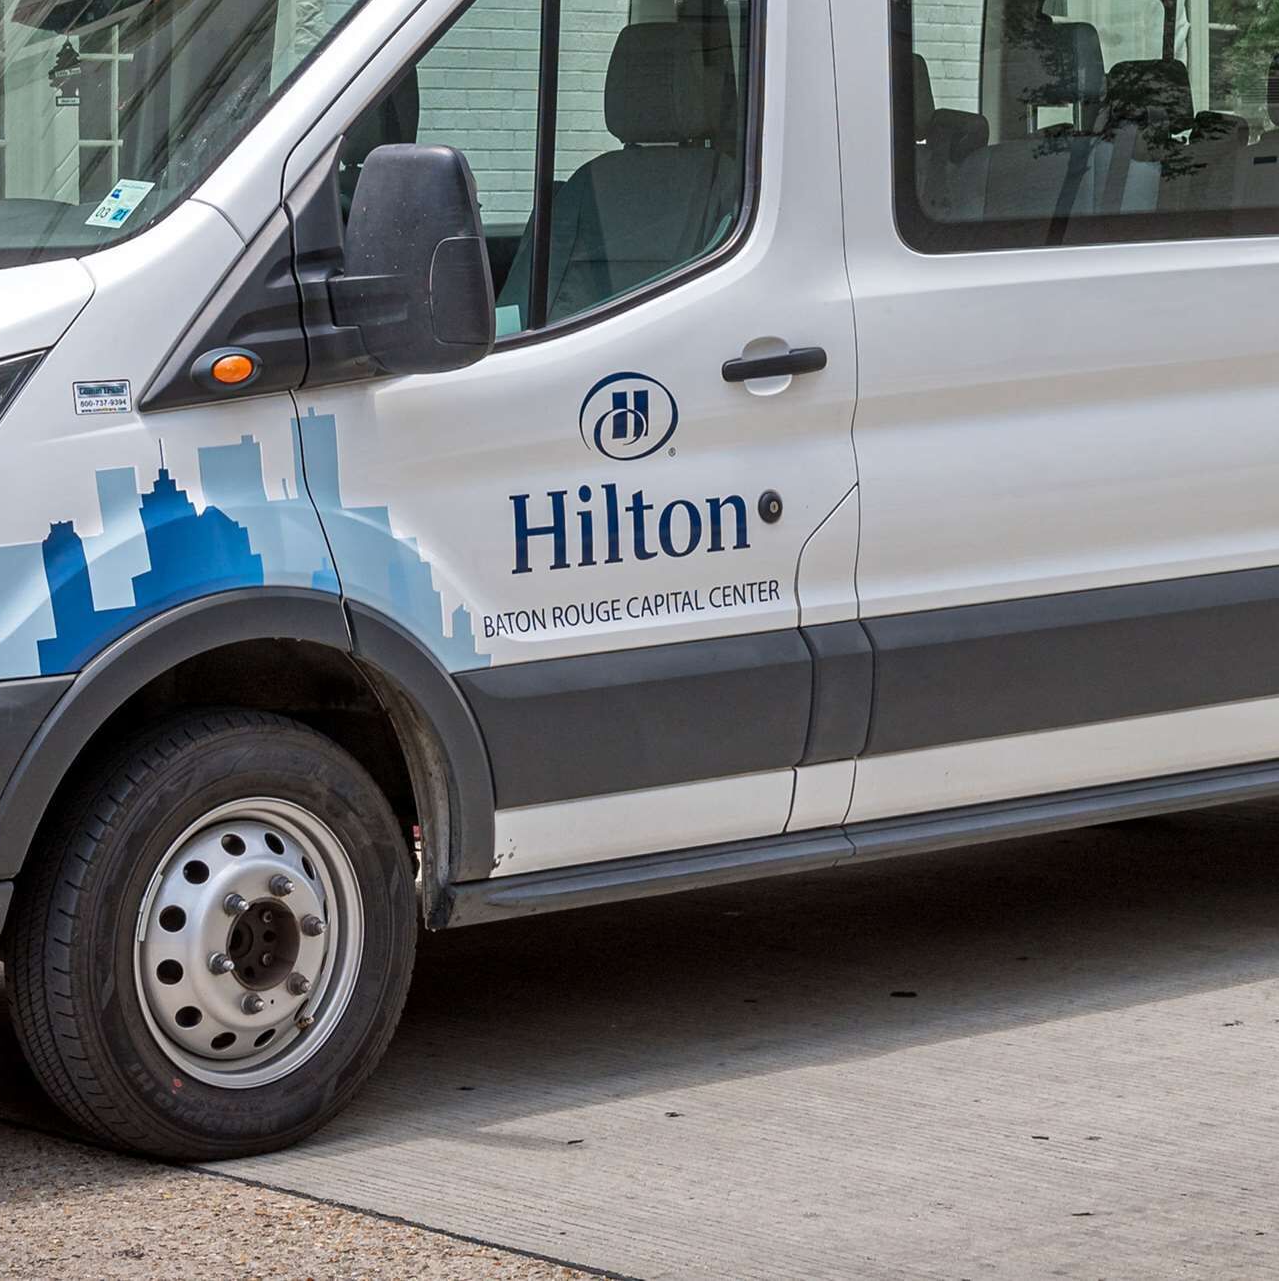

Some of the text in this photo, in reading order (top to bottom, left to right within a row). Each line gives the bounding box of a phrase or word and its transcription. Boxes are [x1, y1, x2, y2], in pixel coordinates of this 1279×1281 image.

[95, 207, 129, 221] 03 21
[80, 399, 127, 407] 800-737-9394
[509, 483, 751, 575] Hilton
[483, 579, 781, 638] BATON ROUGE CAPITAL CENTER
